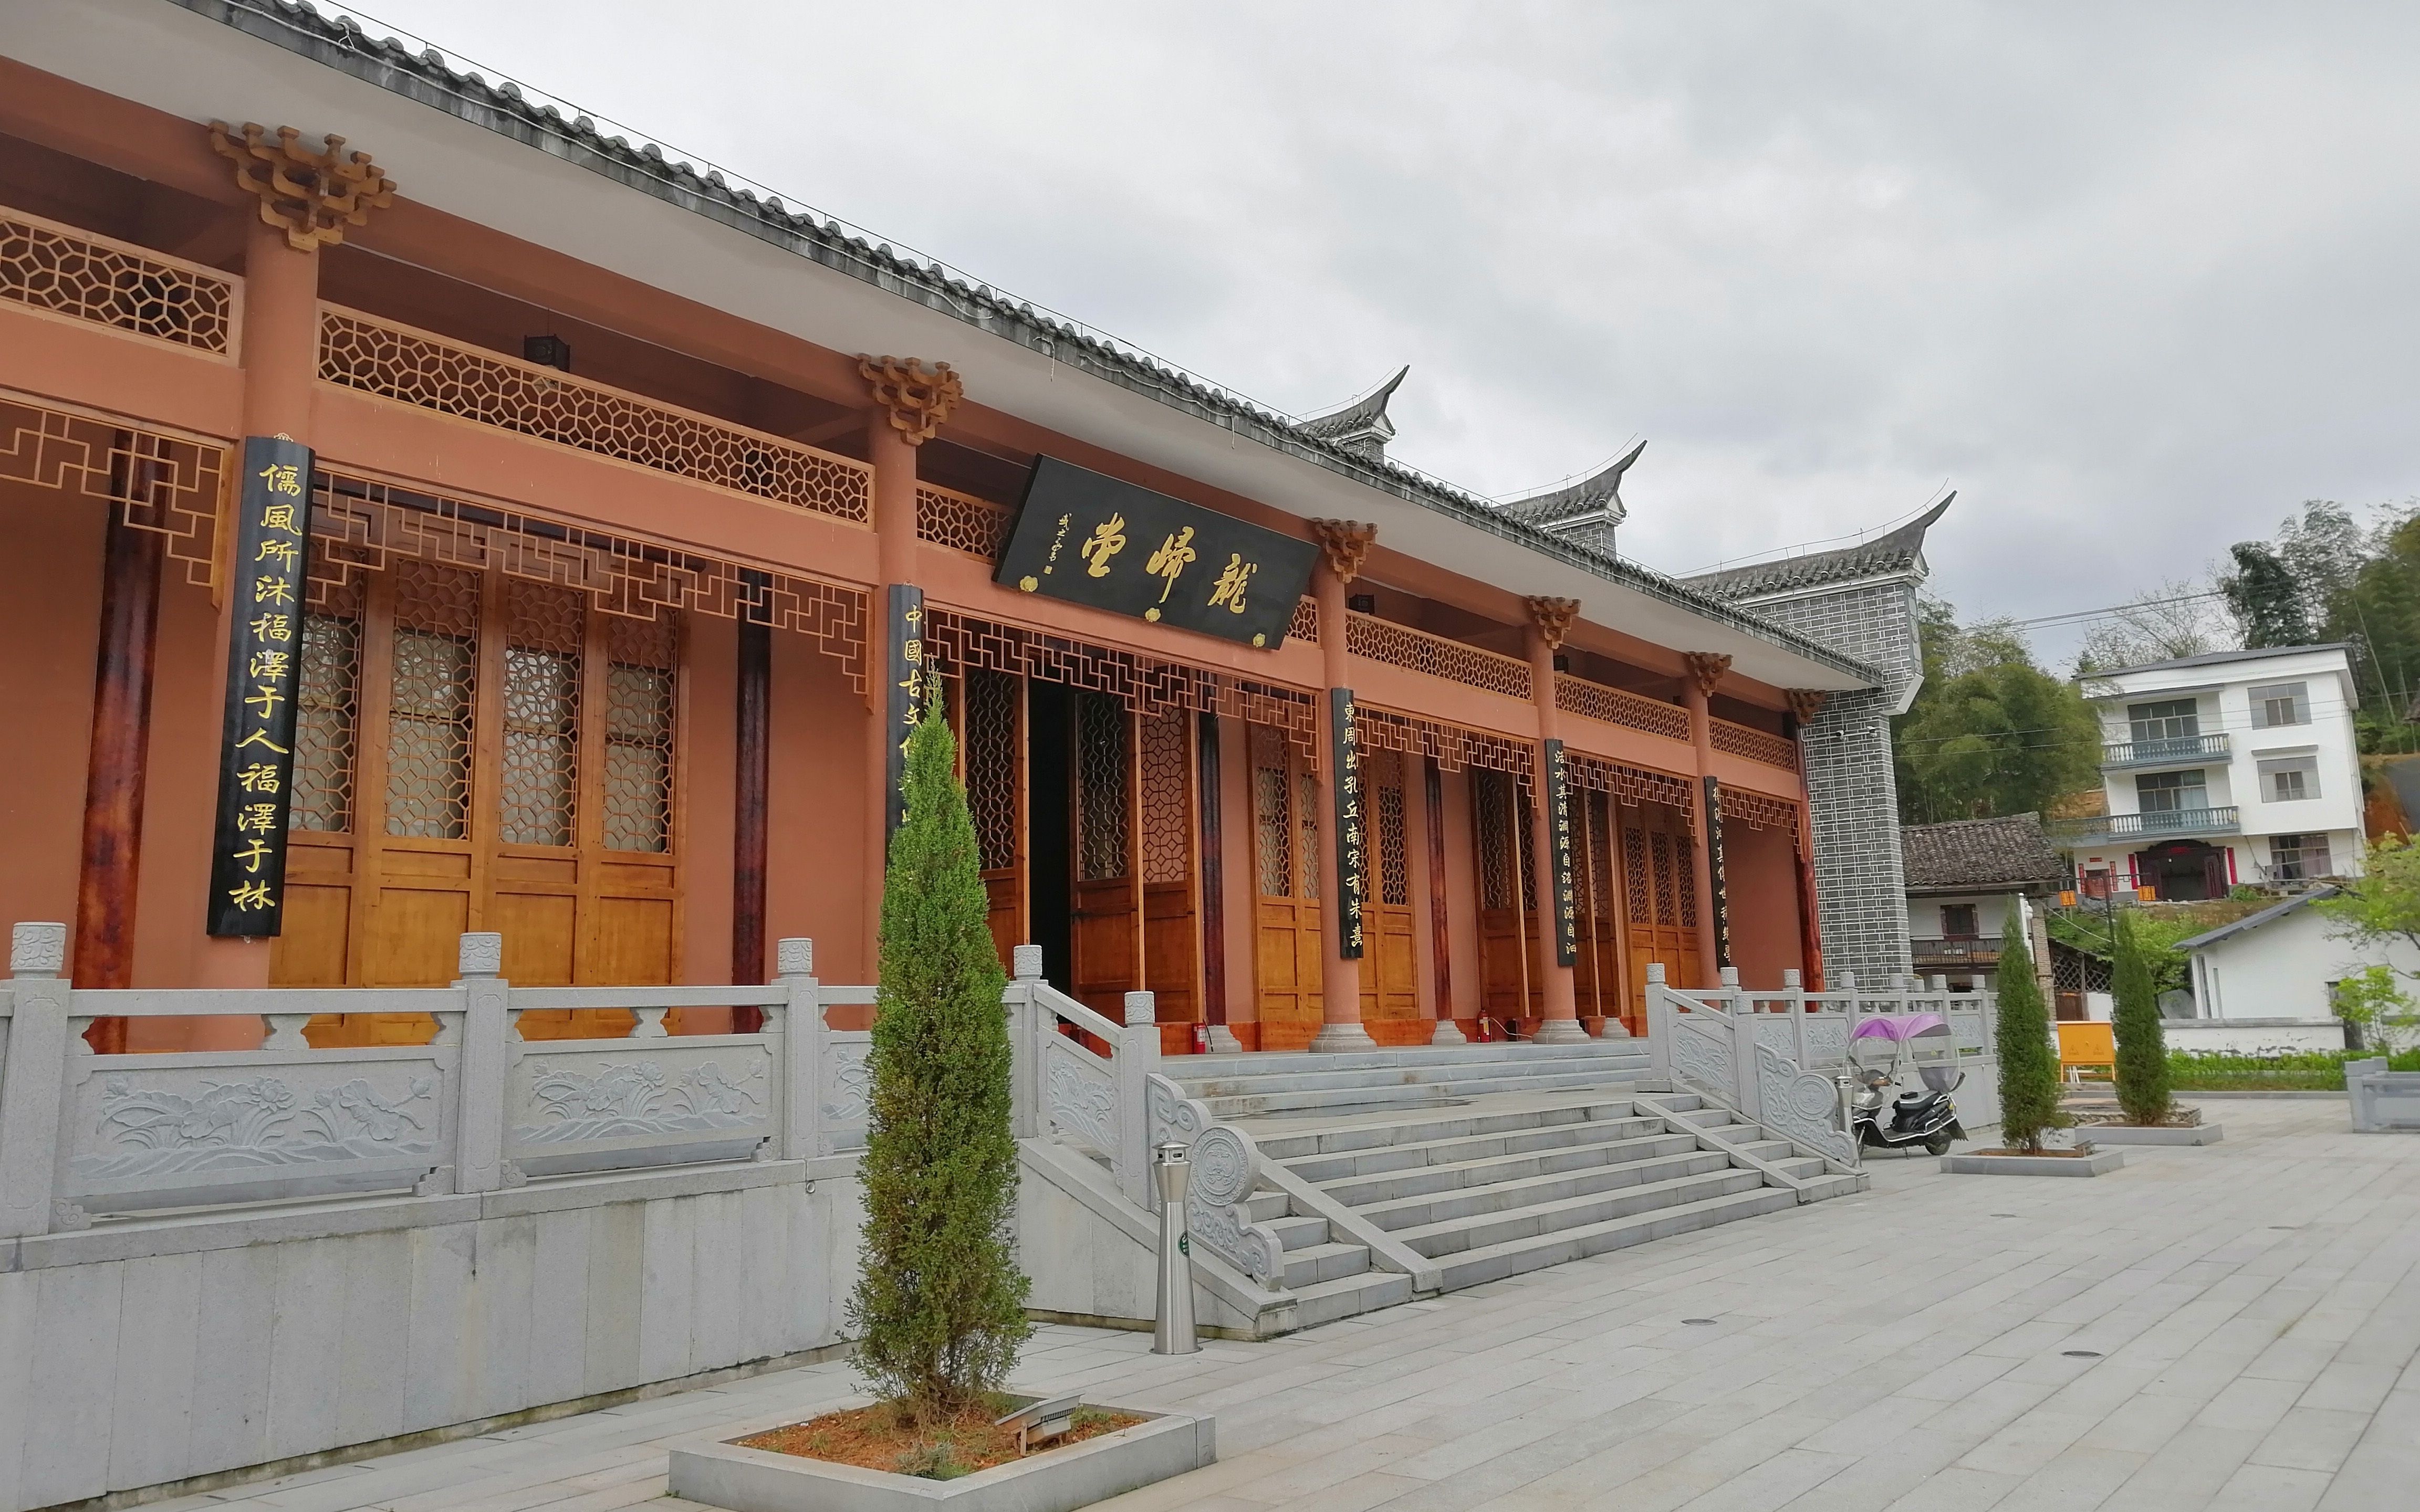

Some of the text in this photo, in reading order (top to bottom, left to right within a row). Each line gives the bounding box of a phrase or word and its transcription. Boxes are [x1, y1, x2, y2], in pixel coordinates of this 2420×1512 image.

[228, 463, 301, 912] 儒風所沐福澤于人福澤于林
